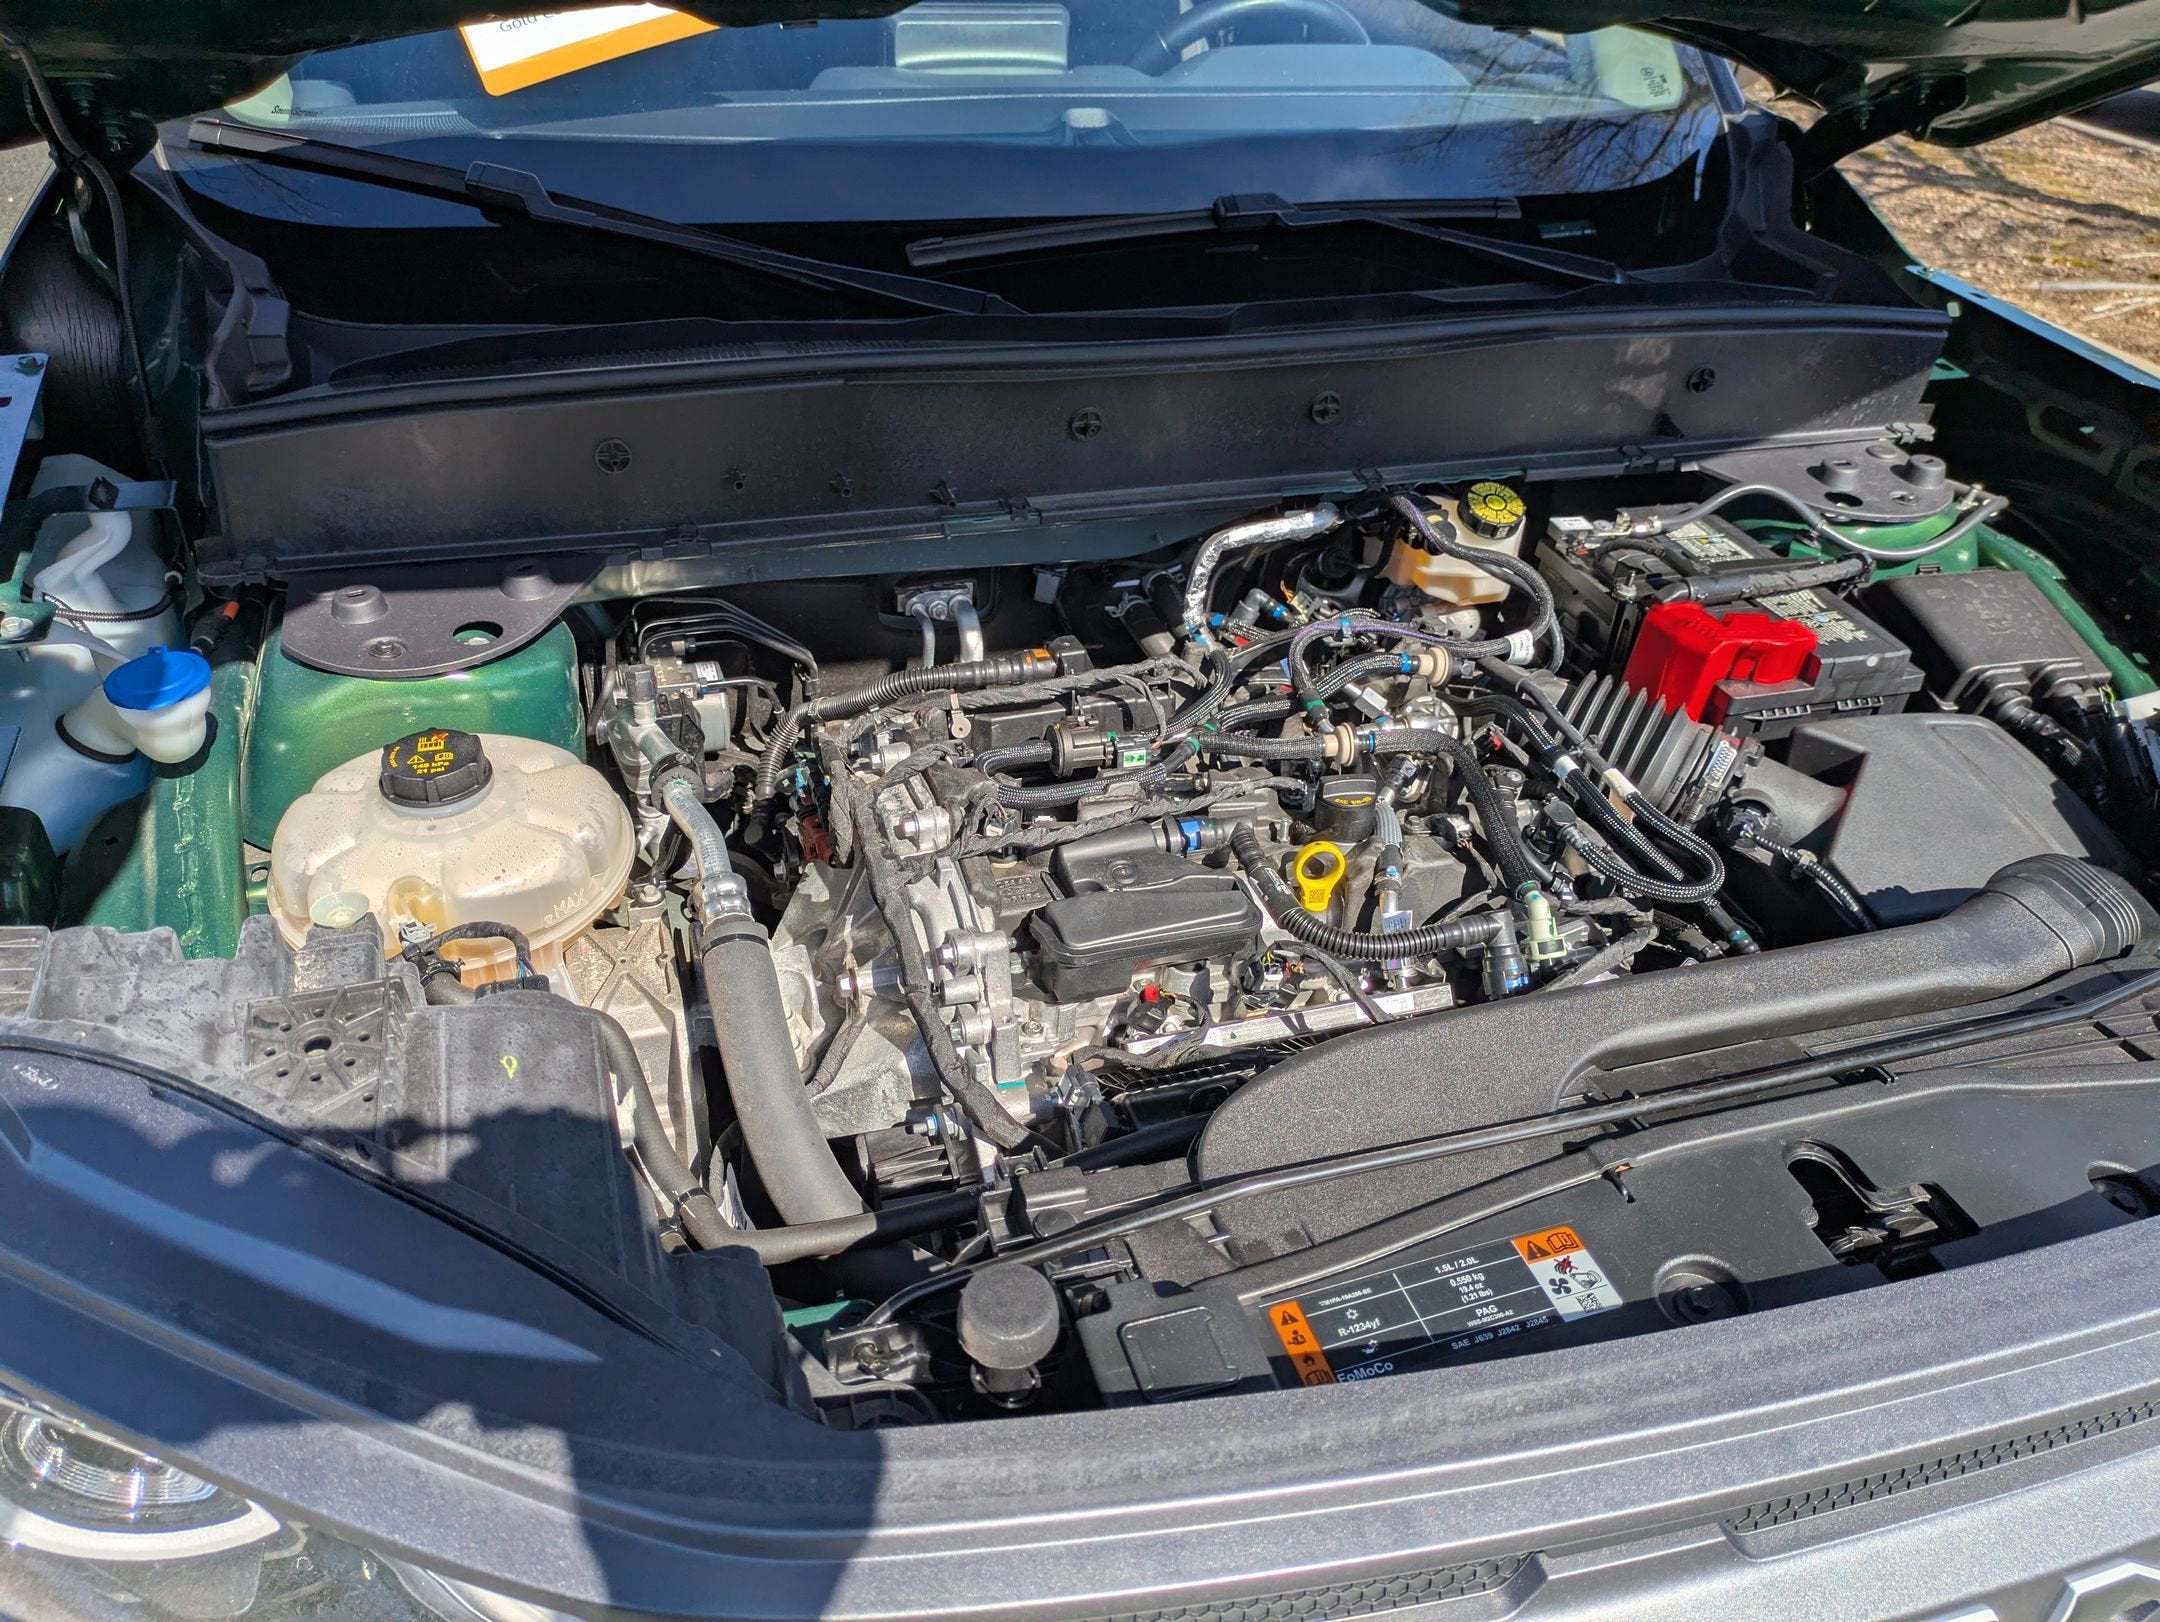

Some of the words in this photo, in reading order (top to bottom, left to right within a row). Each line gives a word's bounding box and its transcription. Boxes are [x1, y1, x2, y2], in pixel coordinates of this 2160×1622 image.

[553, 887, 589, 919] MAX
[1434, 1265, 1454, 1274] 1.5L
[1459, 1256, 1480, 1267] 2.0L
[1449, 1275, 1472, 1287] 0.550
[1471, 1272, 1486, 1282] kg
[1459, 1285, 1475, 1294] 19.4
[1460, 1293, 1478, 1304] (1.21
[1478, 1288, 1494, 1299] lbs)
[1475, 1304, 1499, 1318] PAG
[1337, 1317, 1381, 1337] R-1234yf
[1451, 1338, 1471, 1350] SAE
[1474, 1331, 1494, 1344] J639
[1497, 1324, 1521, 1337] J2842
[1525, 1315, 1549, 1328] J2845
[1337, 1361, 1394, 1384] FoMoCo
